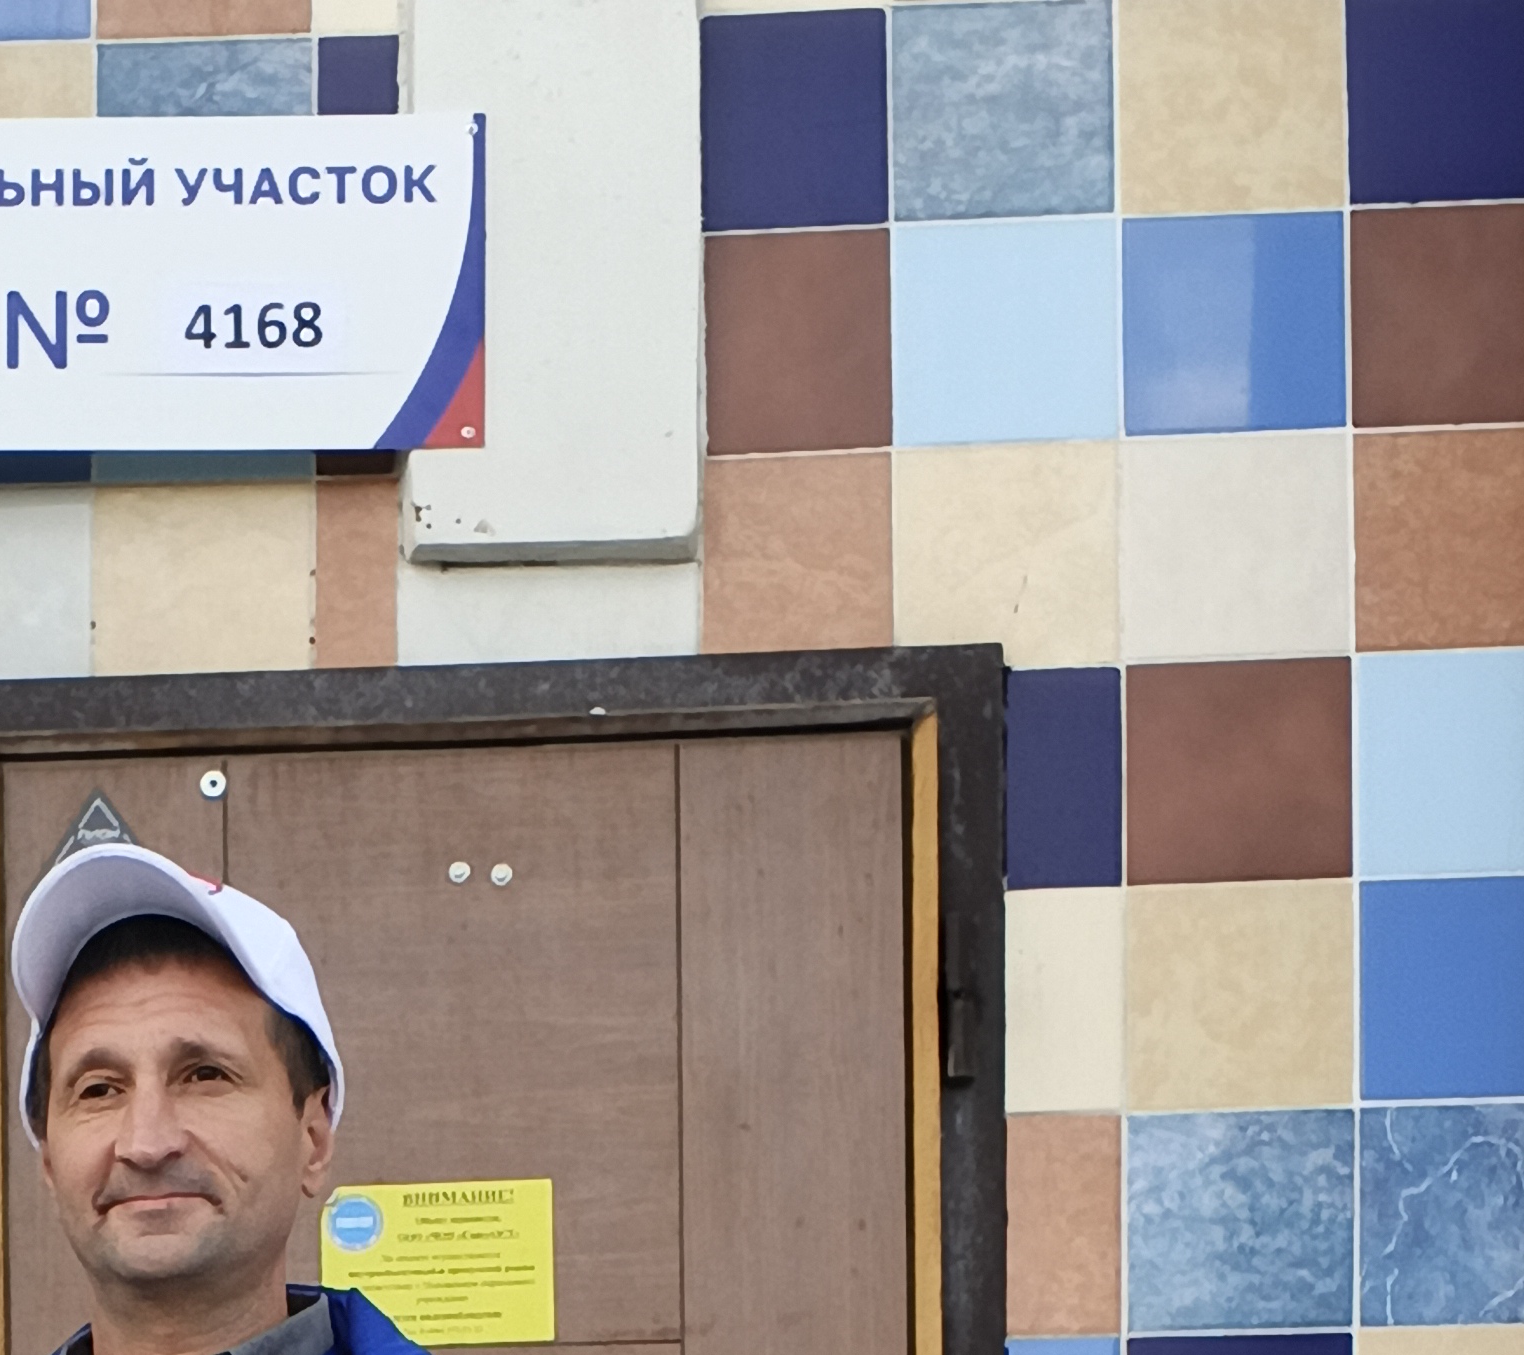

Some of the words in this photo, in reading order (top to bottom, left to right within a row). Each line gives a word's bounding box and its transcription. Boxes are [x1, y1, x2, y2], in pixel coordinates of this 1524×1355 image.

[174, 164, 438, 207] УЧАСТОК
[6, 289, 110, 370] №
[184, 301, 323, 350] 4168
